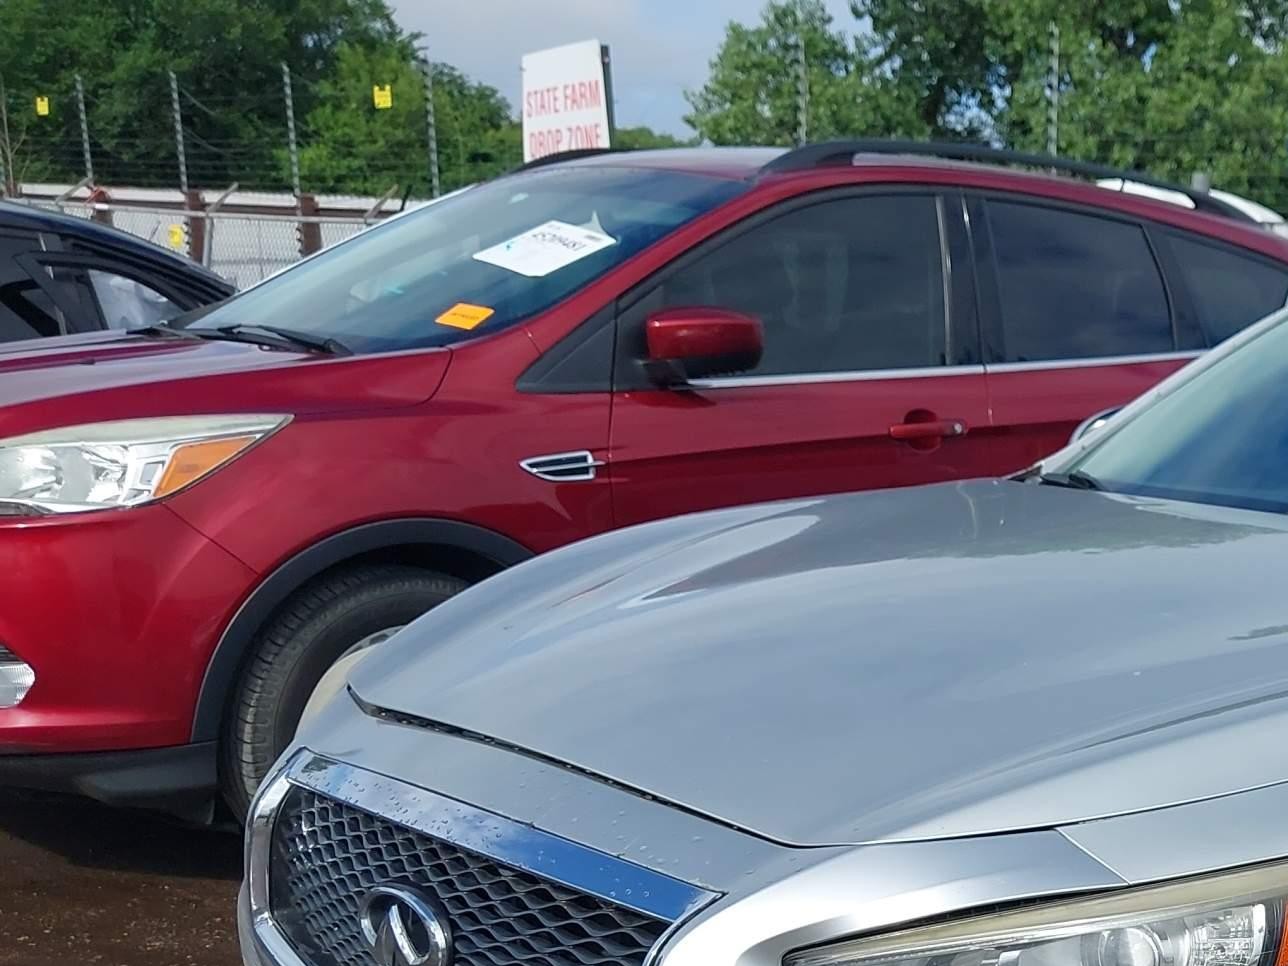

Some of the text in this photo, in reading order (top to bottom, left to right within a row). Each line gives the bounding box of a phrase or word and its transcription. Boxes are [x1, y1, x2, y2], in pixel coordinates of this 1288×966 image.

[526, 80, 601, 118] STATE FARM
[528, 123, 601, 158] DROP ZONE
